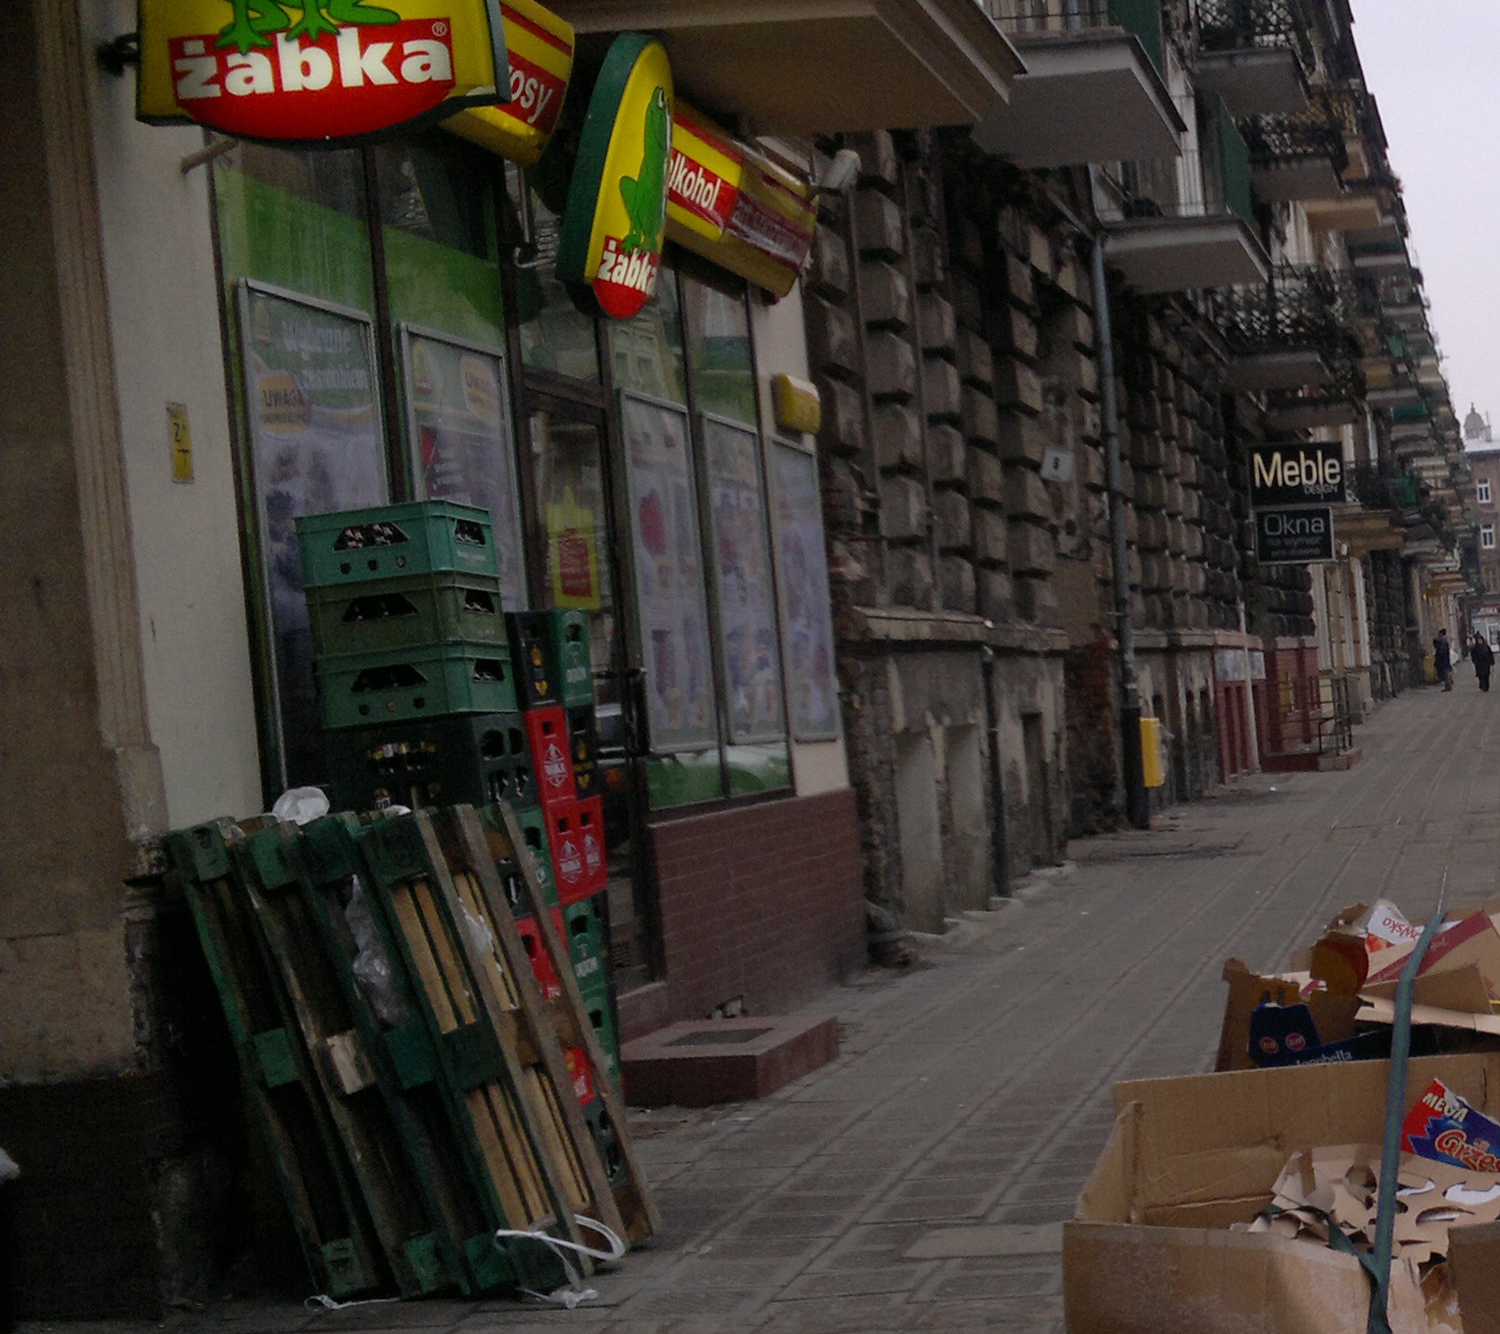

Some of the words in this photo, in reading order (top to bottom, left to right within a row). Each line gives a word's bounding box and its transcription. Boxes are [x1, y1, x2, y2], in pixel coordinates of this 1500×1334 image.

[173, 26, 453, 100] żabka
[508, 64, 554, 125] osy
[1252, 449, 1341, 488] Meble
[1264, 514, 1325, 536] Okna
